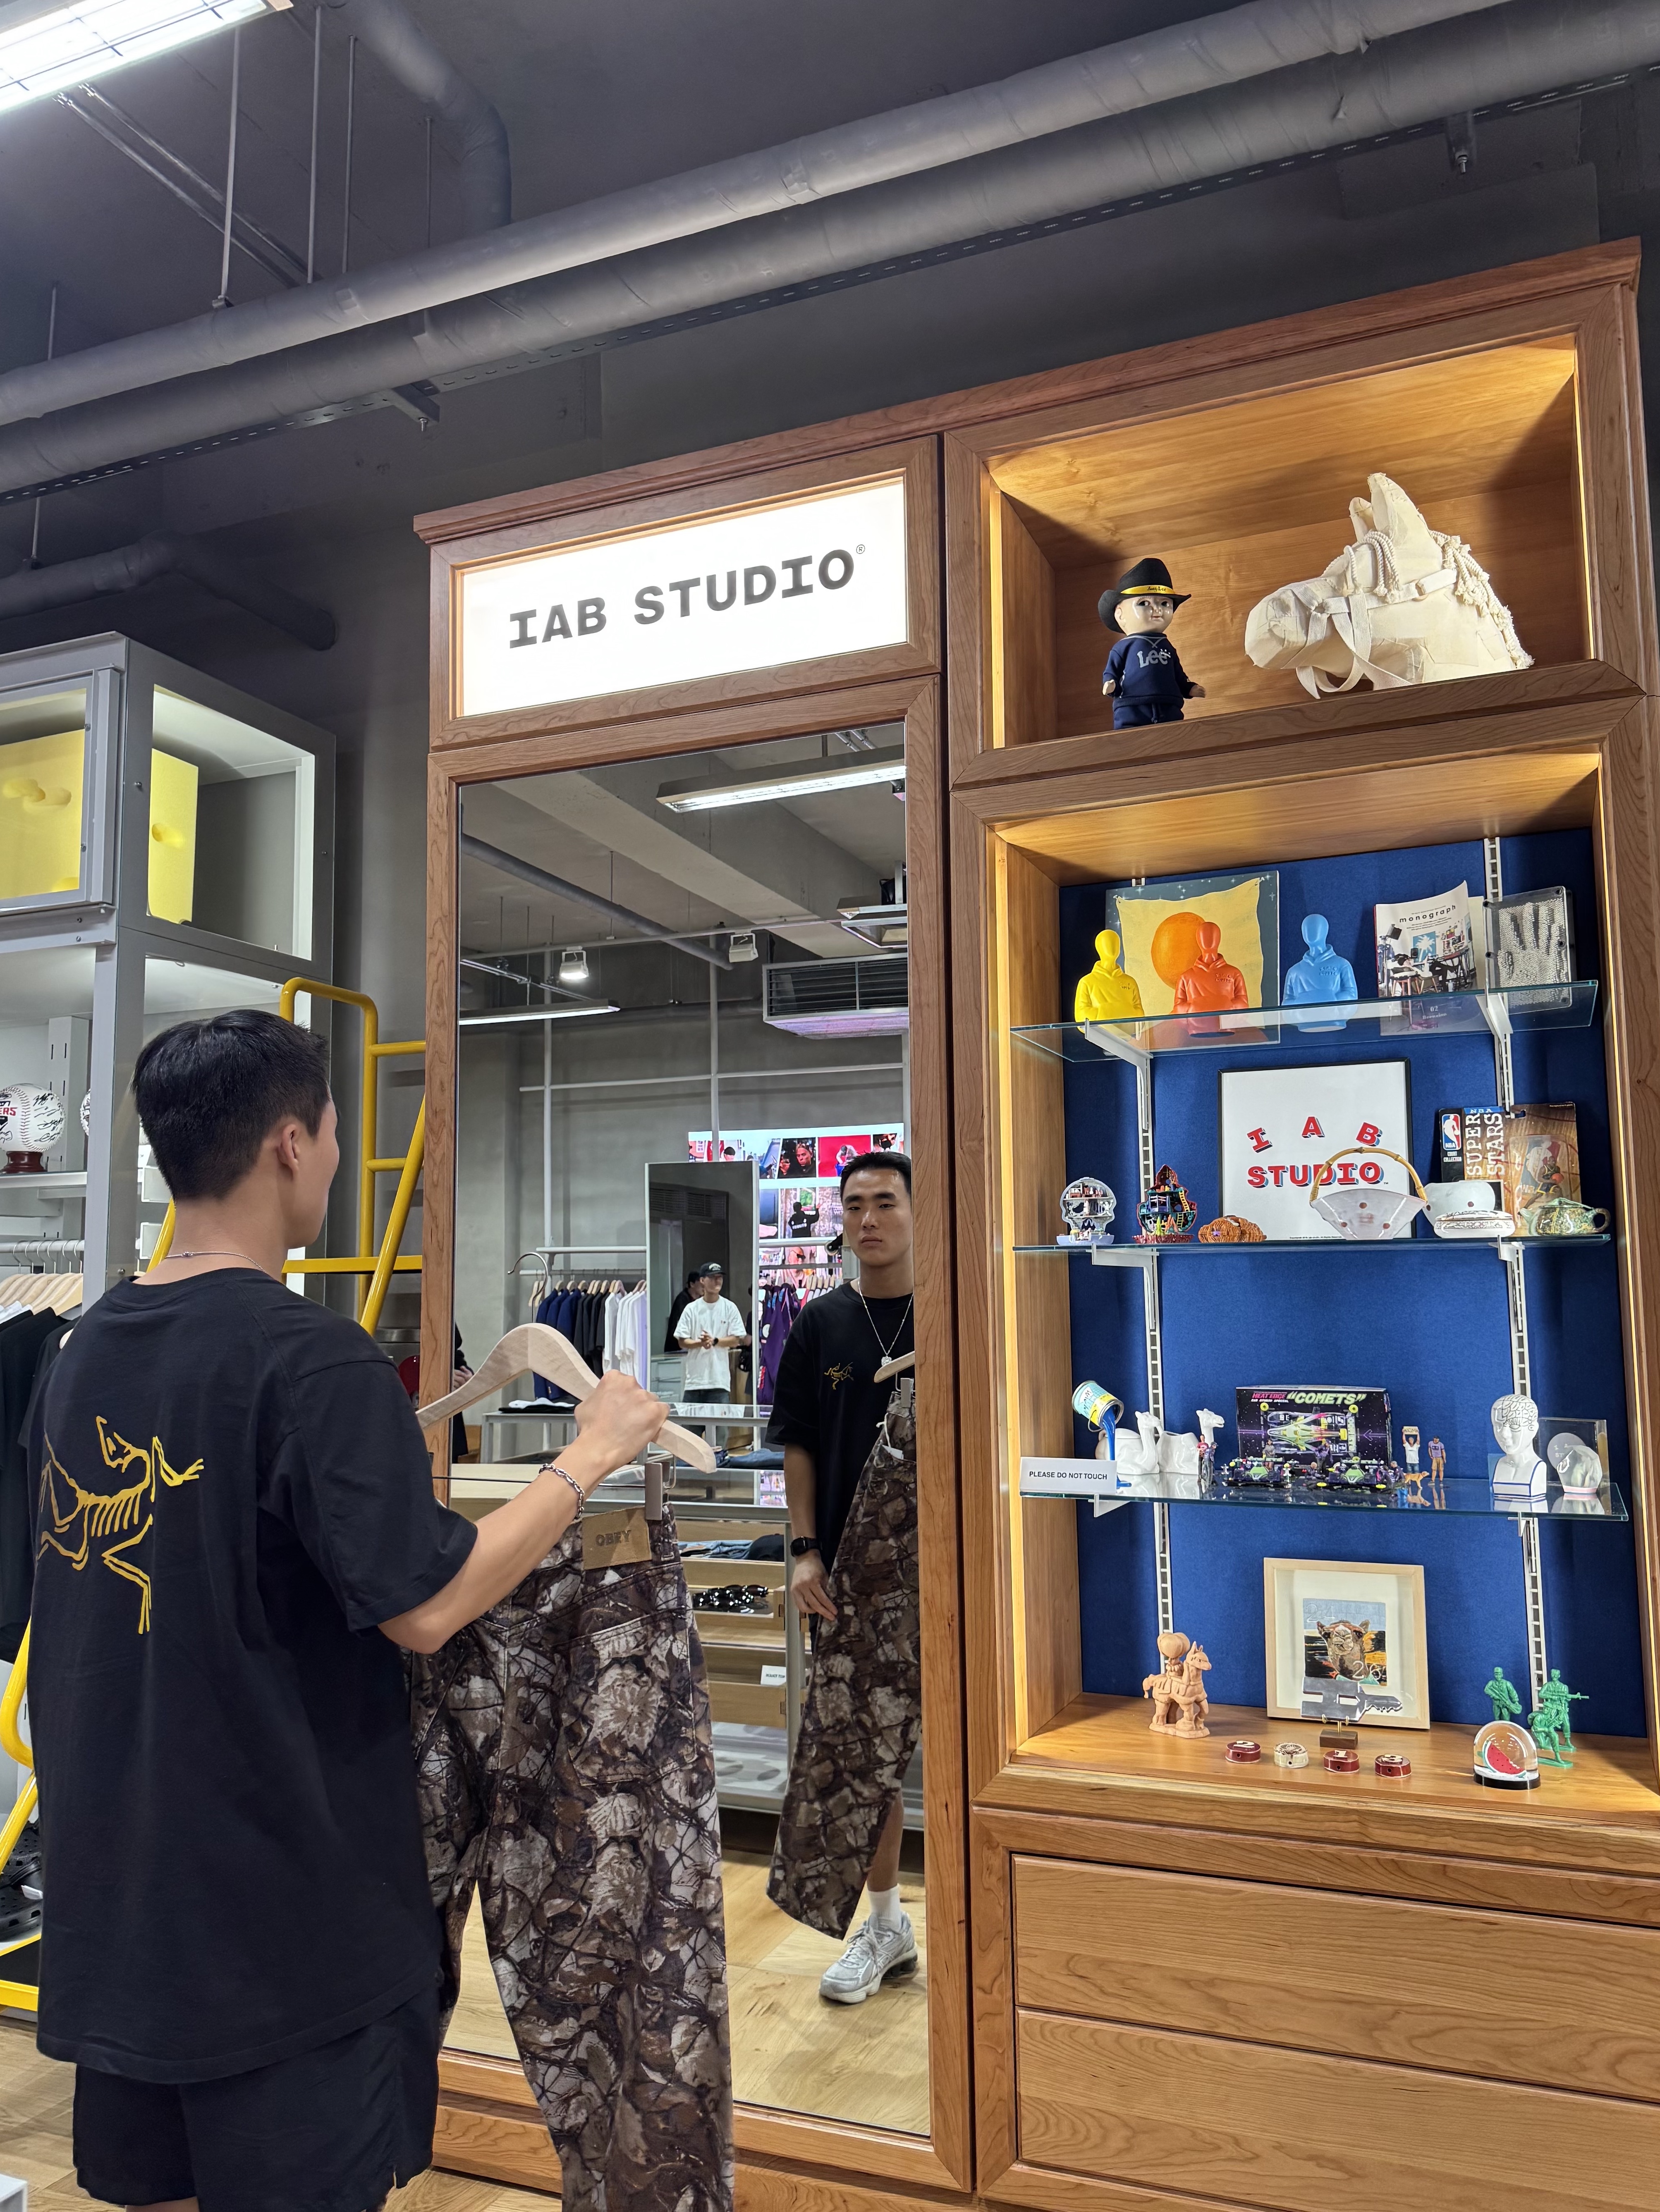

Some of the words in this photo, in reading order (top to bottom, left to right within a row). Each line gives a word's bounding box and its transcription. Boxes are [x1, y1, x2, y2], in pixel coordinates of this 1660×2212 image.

[509, 597, 607, 649] IAB
[1137, 650, 1168, 668] Lee
[1399, 905, 1456, 923] monograph
[1465, 1113, 1483, 1176] SUPER
[1483, 1113, 1505, 1175] STARS
[596, 1530, 631, 1546] OBEY
[1233, 1740, 1255, 1749] 2
[1334, 1749, 1348, 1758] 1
[1381, 1754, 1403, 1763] 3
